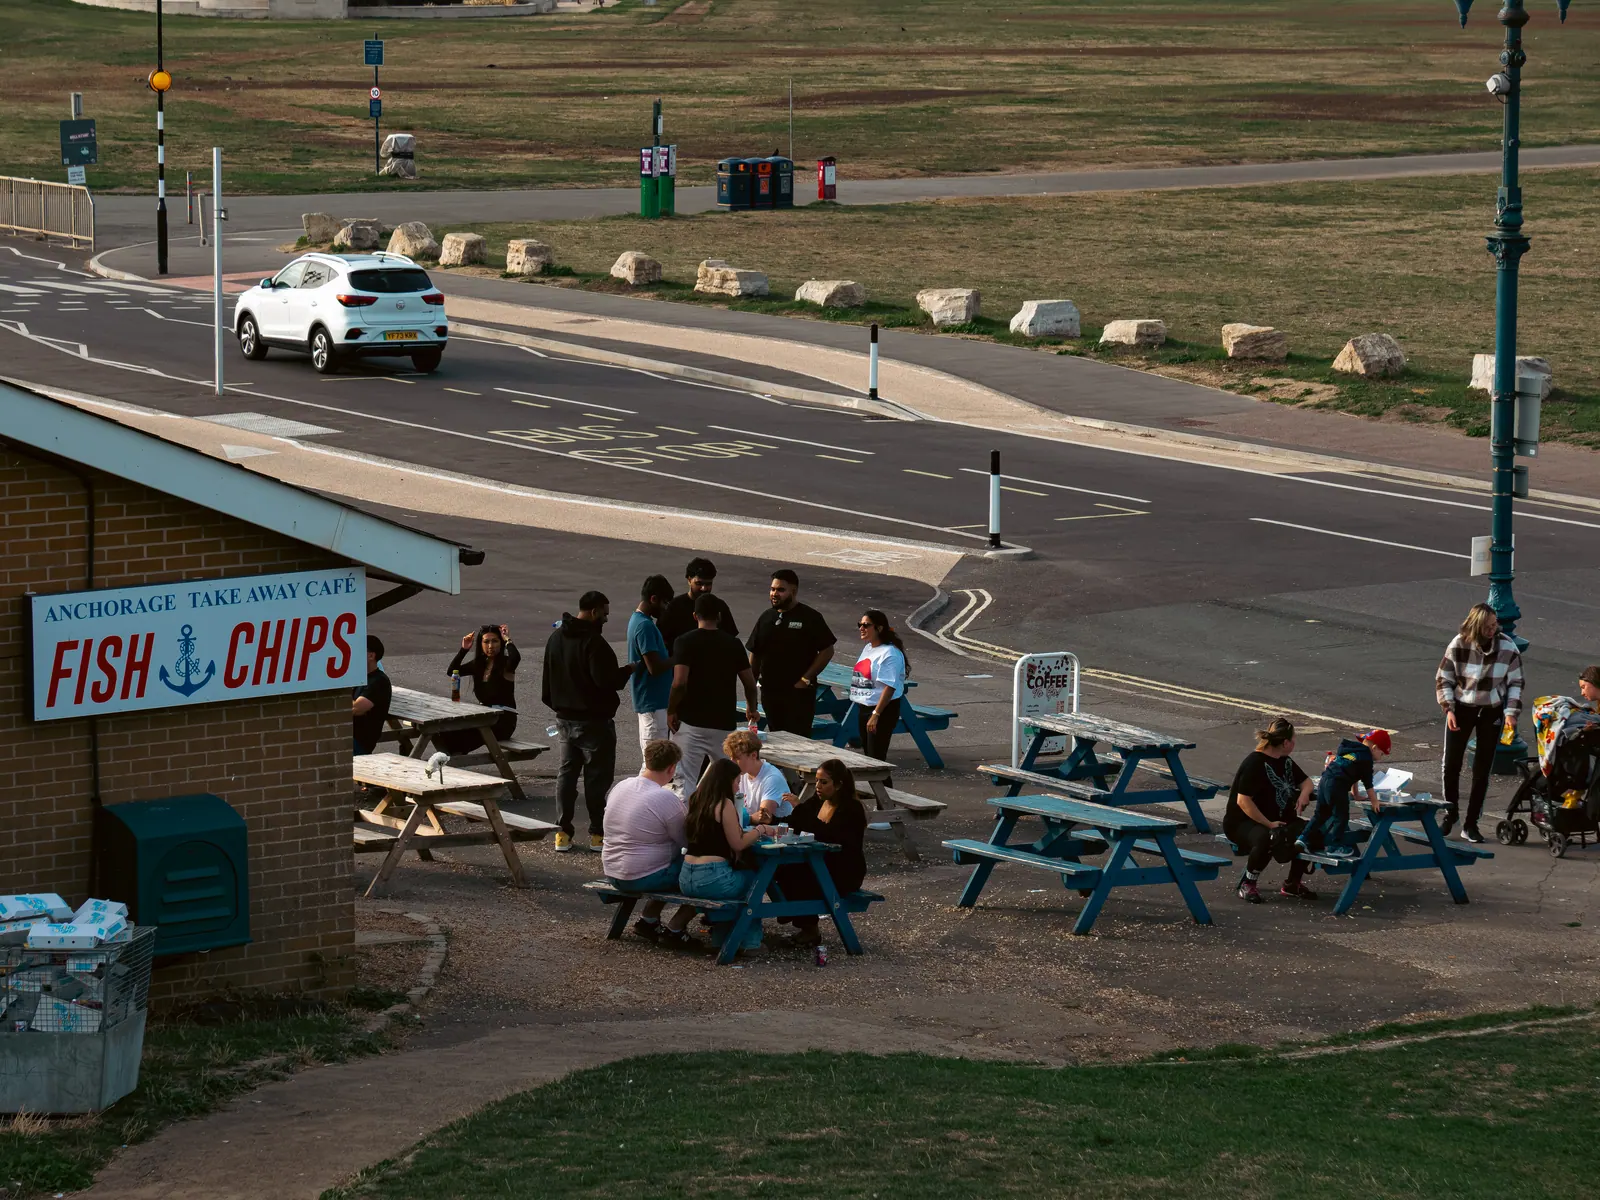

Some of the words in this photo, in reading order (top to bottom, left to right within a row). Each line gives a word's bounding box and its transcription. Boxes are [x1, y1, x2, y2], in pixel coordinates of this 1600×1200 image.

[372, 89, 379, 97] 10
[487, 425, 659, 444] BUS
[568, 441, 763, 464] STOP
[44, 594, 177, 623] ANCHORAGE
[188, 588, 242, 609] TAKE
[246, 581, 301, 603] AWAY
[304, 572, 357, 597] CAFÉ
[46, 632, 155, 708] FISH
[223, 612, 357, 689] CHIPS
[1027, 674, 1068, 689] COFFEE
